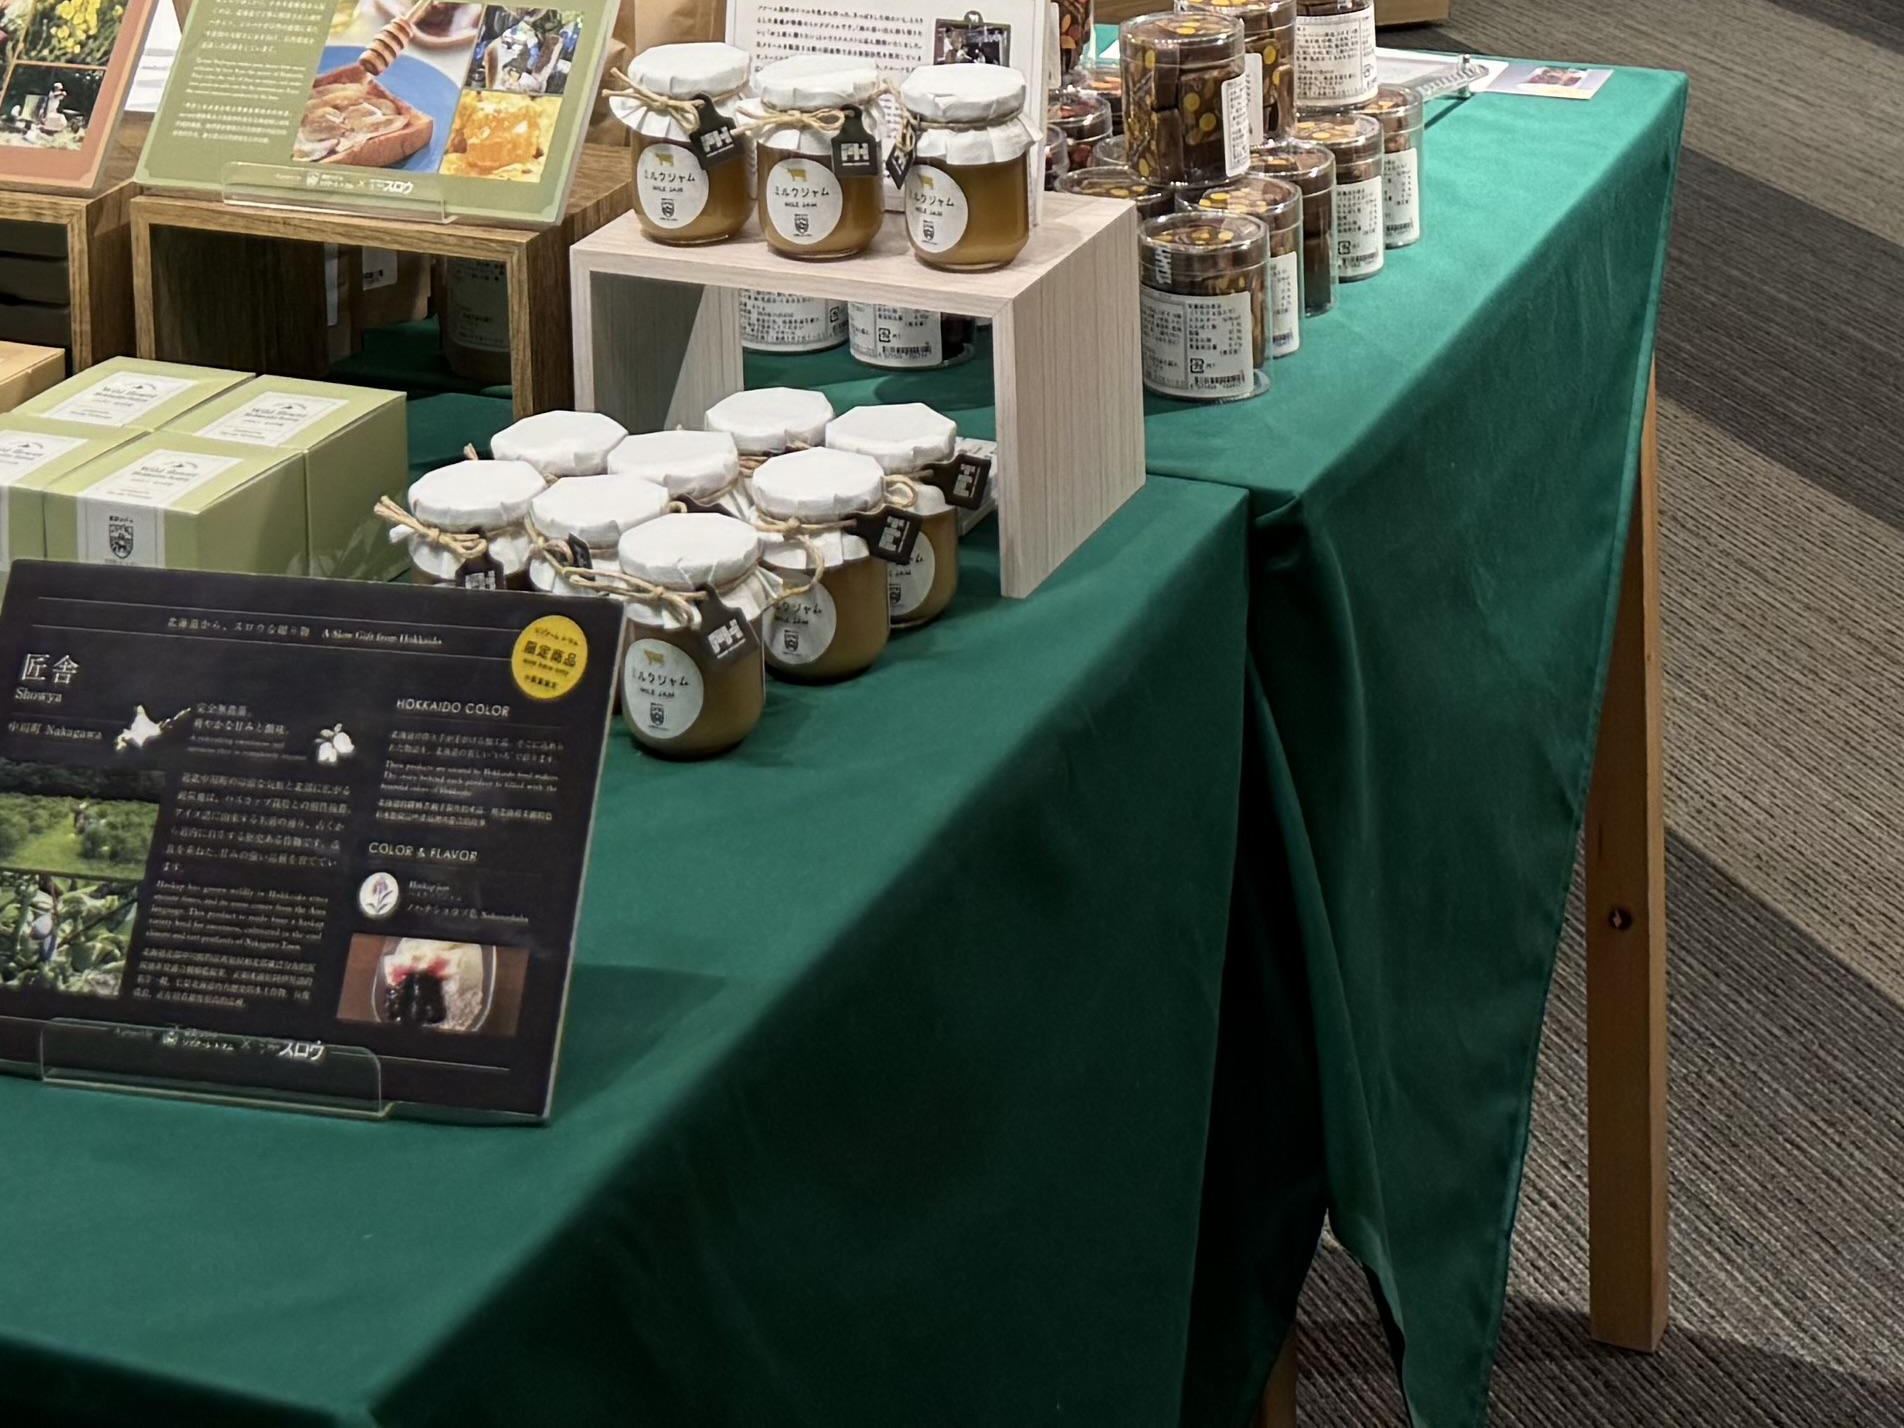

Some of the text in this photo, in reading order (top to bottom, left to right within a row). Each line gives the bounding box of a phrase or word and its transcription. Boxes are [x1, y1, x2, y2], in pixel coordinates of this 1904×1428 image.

[383, 179, 413, 195] スロウ
[775, 186, 829, 199] ミルクジャム
[523, 640, 578, 668] 限定商品
[21, 653, 80, 685] 匠舎
[396, 699, 511, 717] HOKKAIDO COLOR
[46, 724, 102, 741] Nakagawa
[369, 842, 478, 862] COLOR & FLAVOR
[278, 1040, 325, 1061] スロウ
